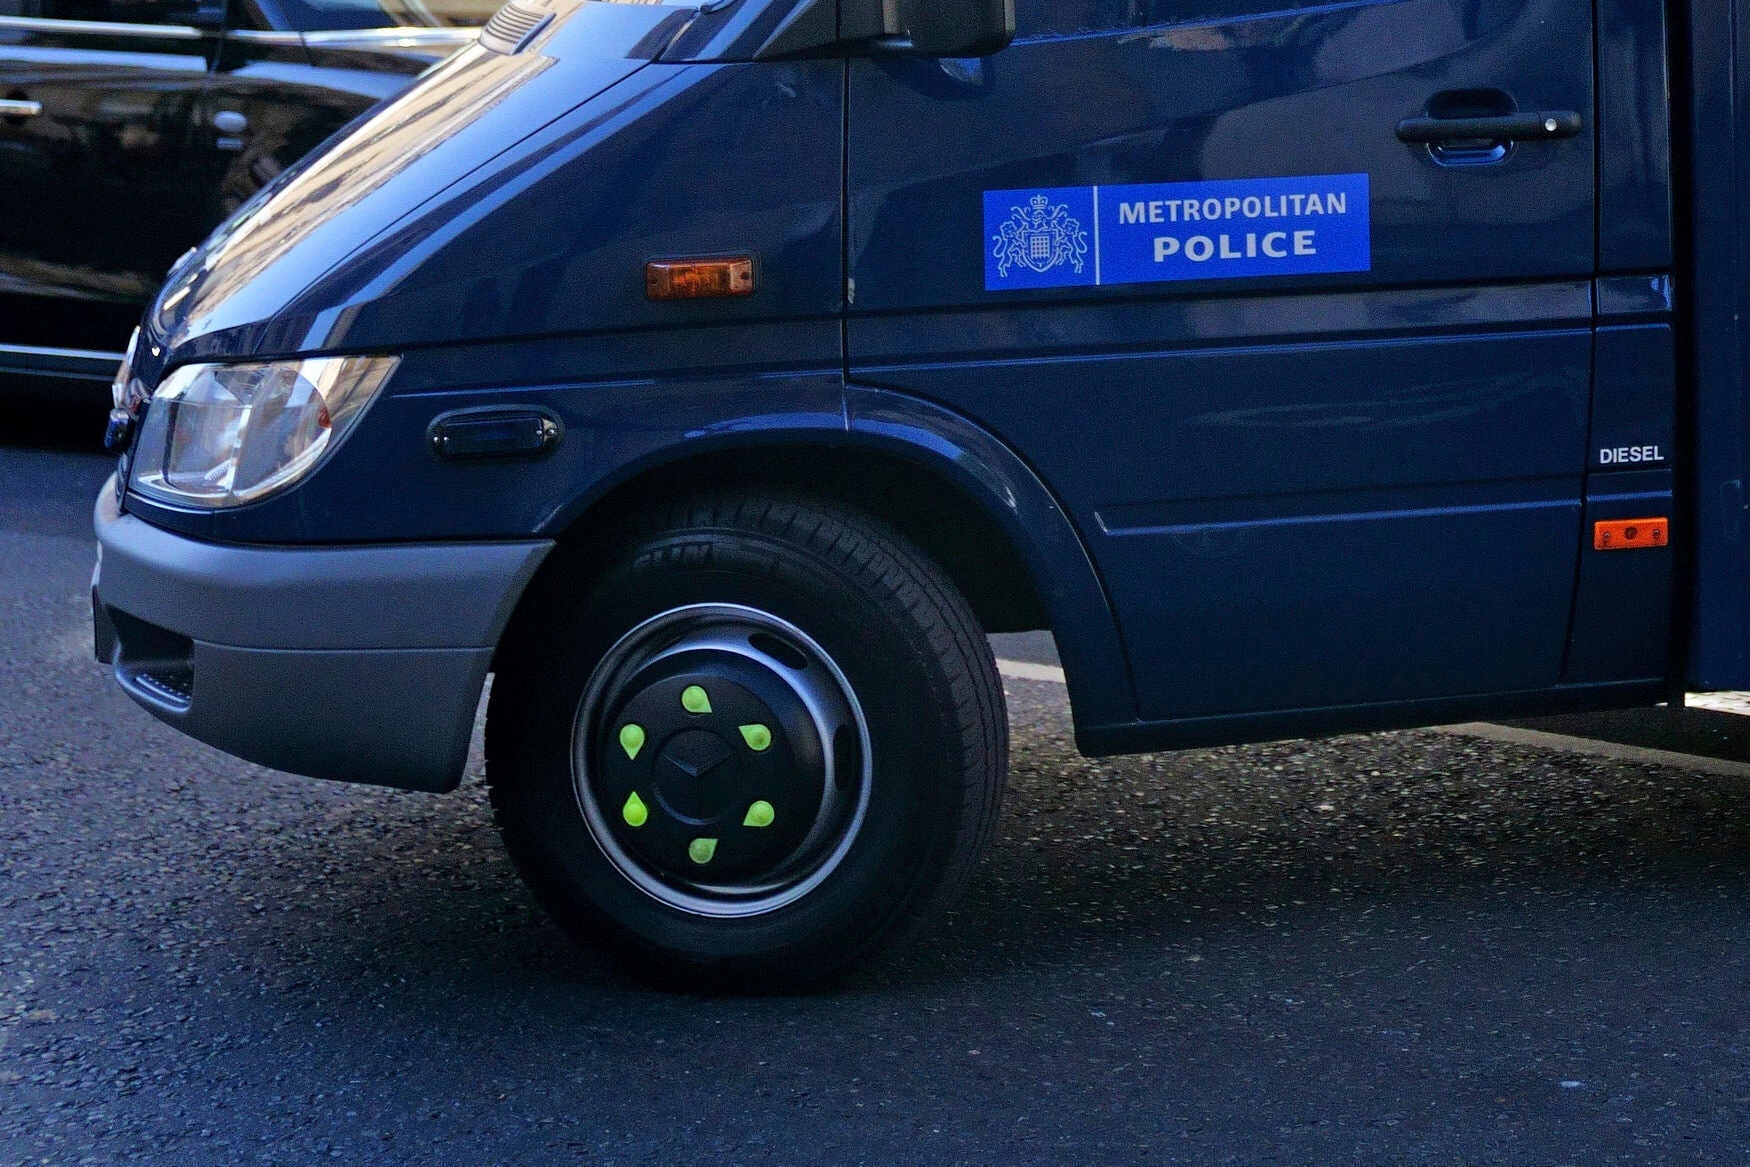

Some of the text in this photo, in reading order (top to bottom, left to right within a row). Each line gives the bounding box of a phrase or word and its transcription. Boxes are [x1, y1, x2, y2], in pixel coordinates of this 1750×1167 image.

[1119, 192, 1347, 225] METROPOLITAN
[1154, 230, 1316, 263] POLICE
[1600, 445, 1664, 464] DIESEL
